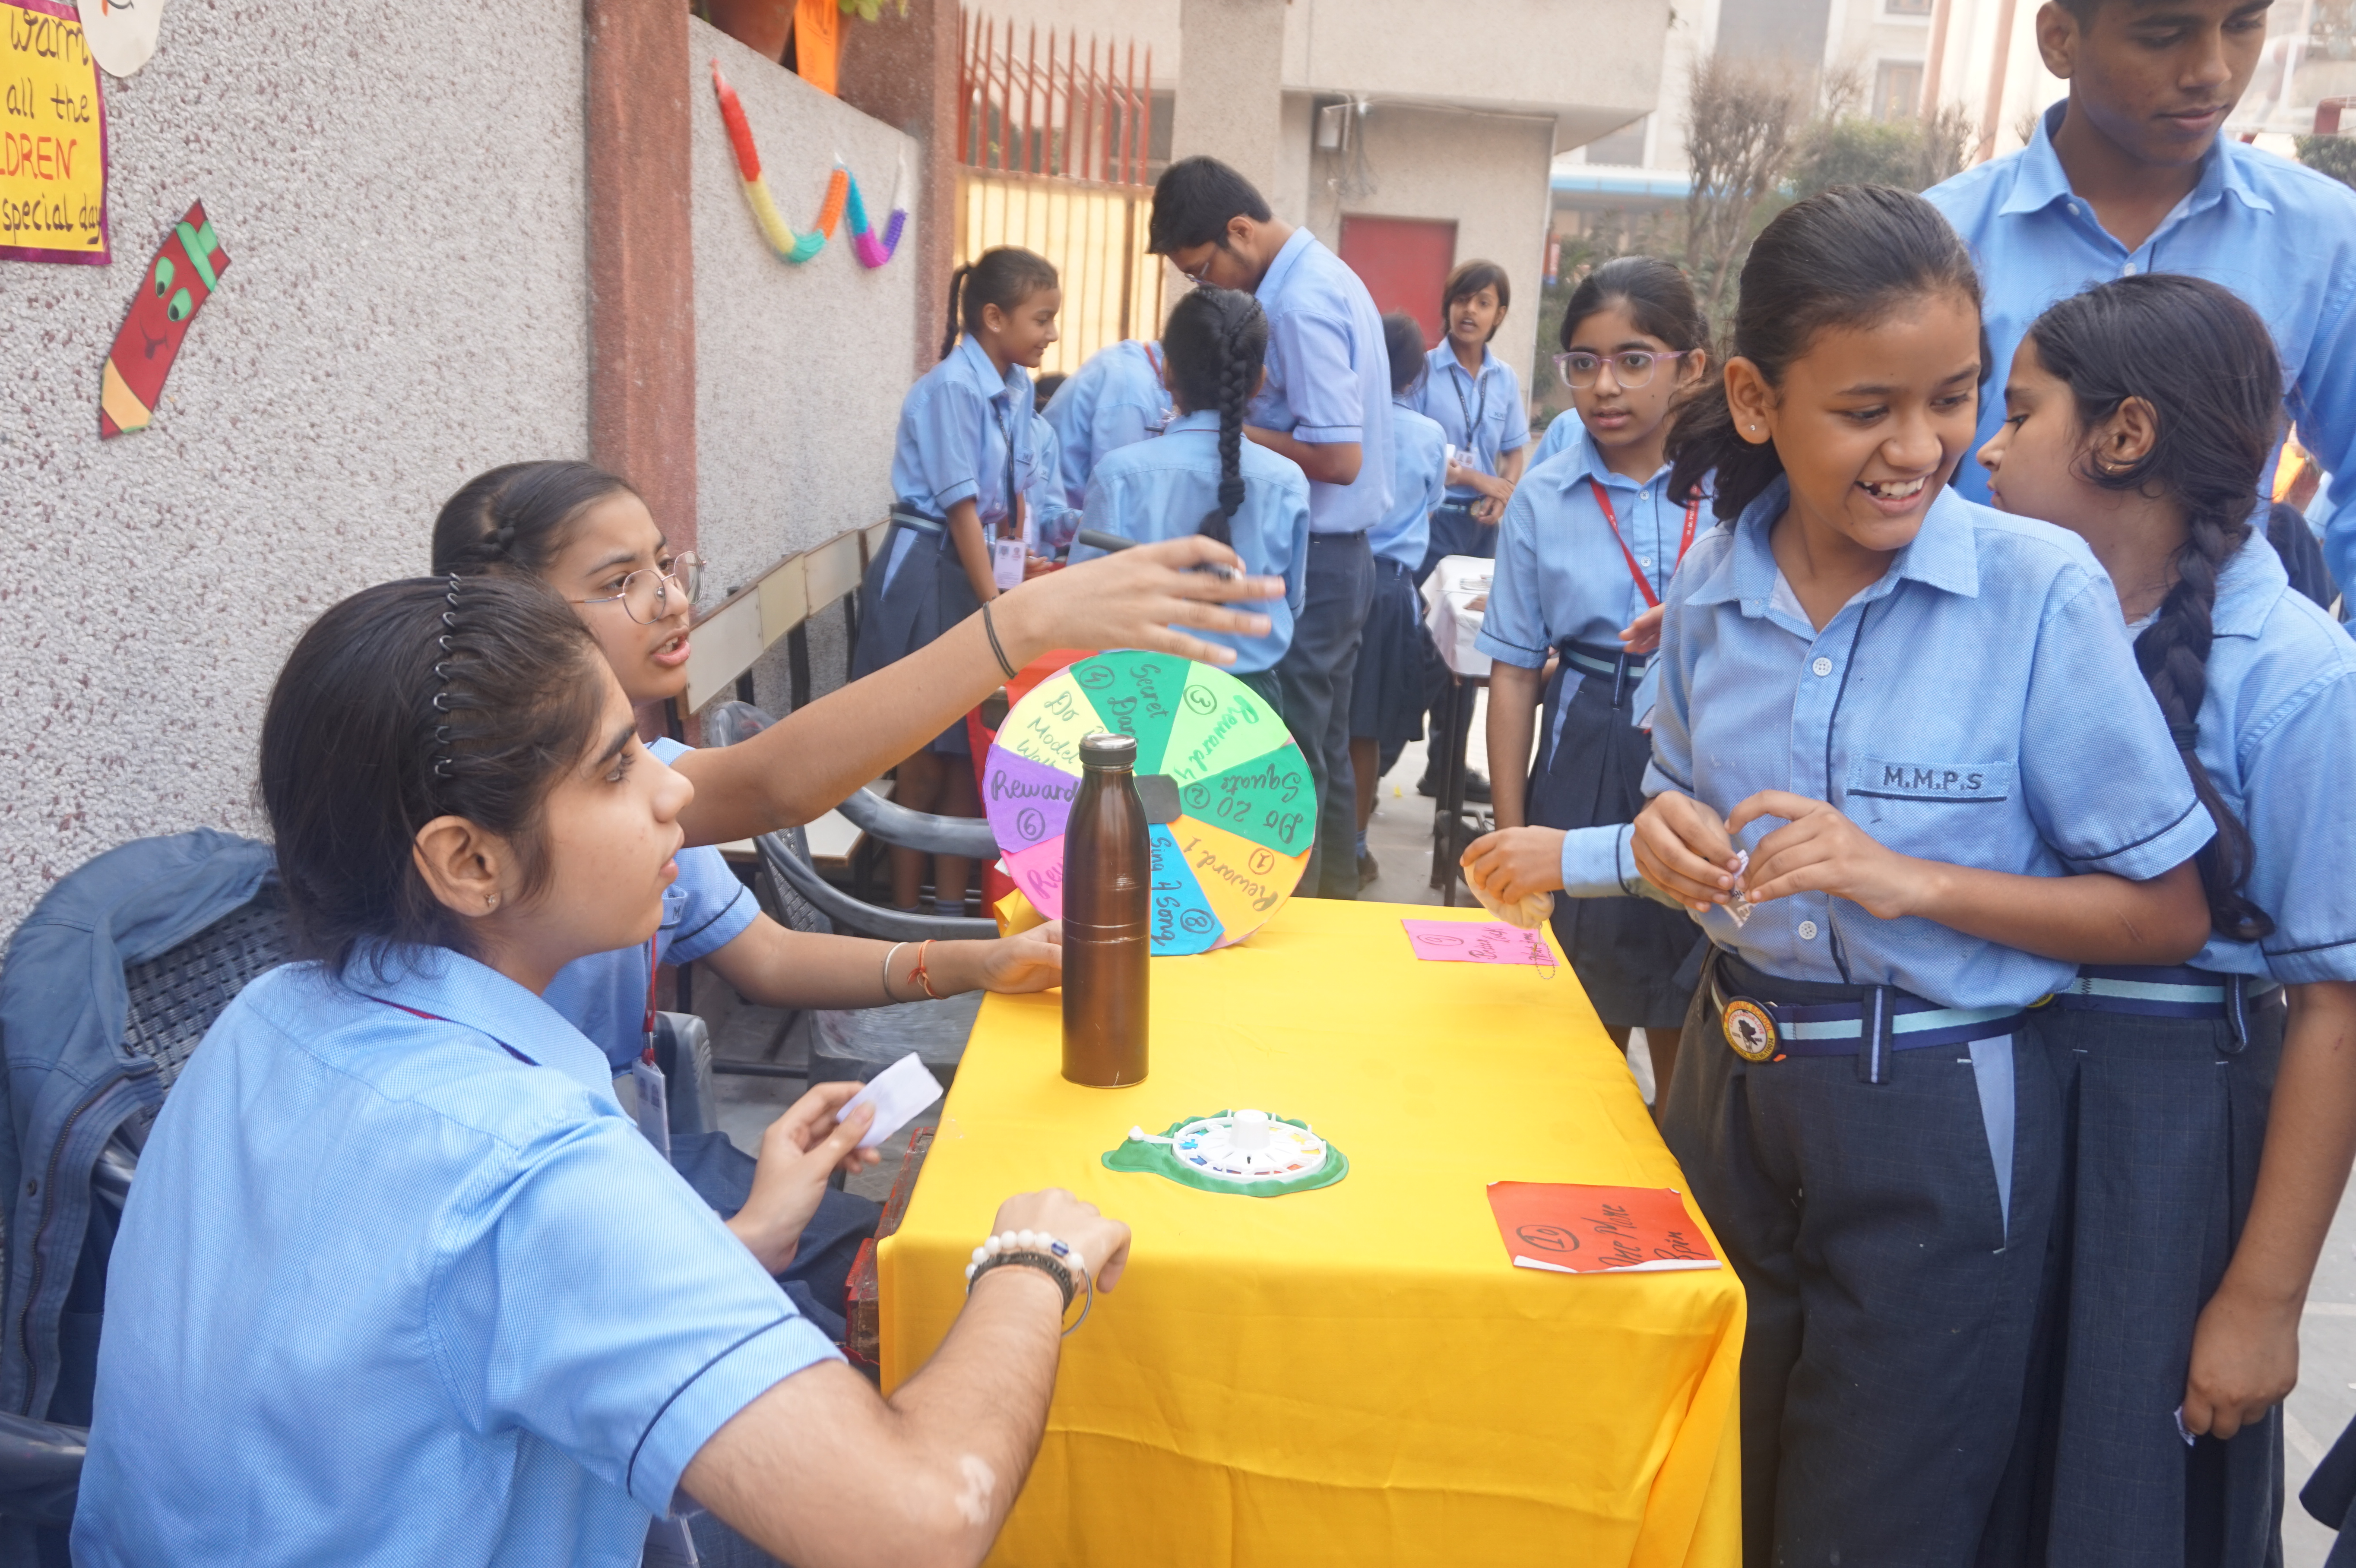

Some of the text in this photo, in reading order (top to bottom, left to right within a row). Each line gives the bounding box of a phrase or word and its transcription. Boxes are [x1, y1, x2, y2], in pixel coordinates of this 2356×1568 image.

[6, 77, 90, 123] all the
[0, 131, 77, 180] DREN
[2, 192, 102, 245] special day
[1044, 690, 1080, 721] Do
[1107, 696, 1139, 745] Dar
[1027, 716, 1080, 764] Model
[1189, 694, 1259, 772] Reward
[991, 769, 1079, 803] Reward
[1220, 762, 1302, 803] Squats
[1883, 765, 1982, 790] M.M.P.S
[1217, 796, 1304, 844] Do 20
[1183, 835, 1279, 912] Reward 1
[1729, 1001, 1749, 1011] PUBLIC
[1751, 1006, 1772, 1033] SCHOOL
[1580, 1204, 1637, 1240] More
